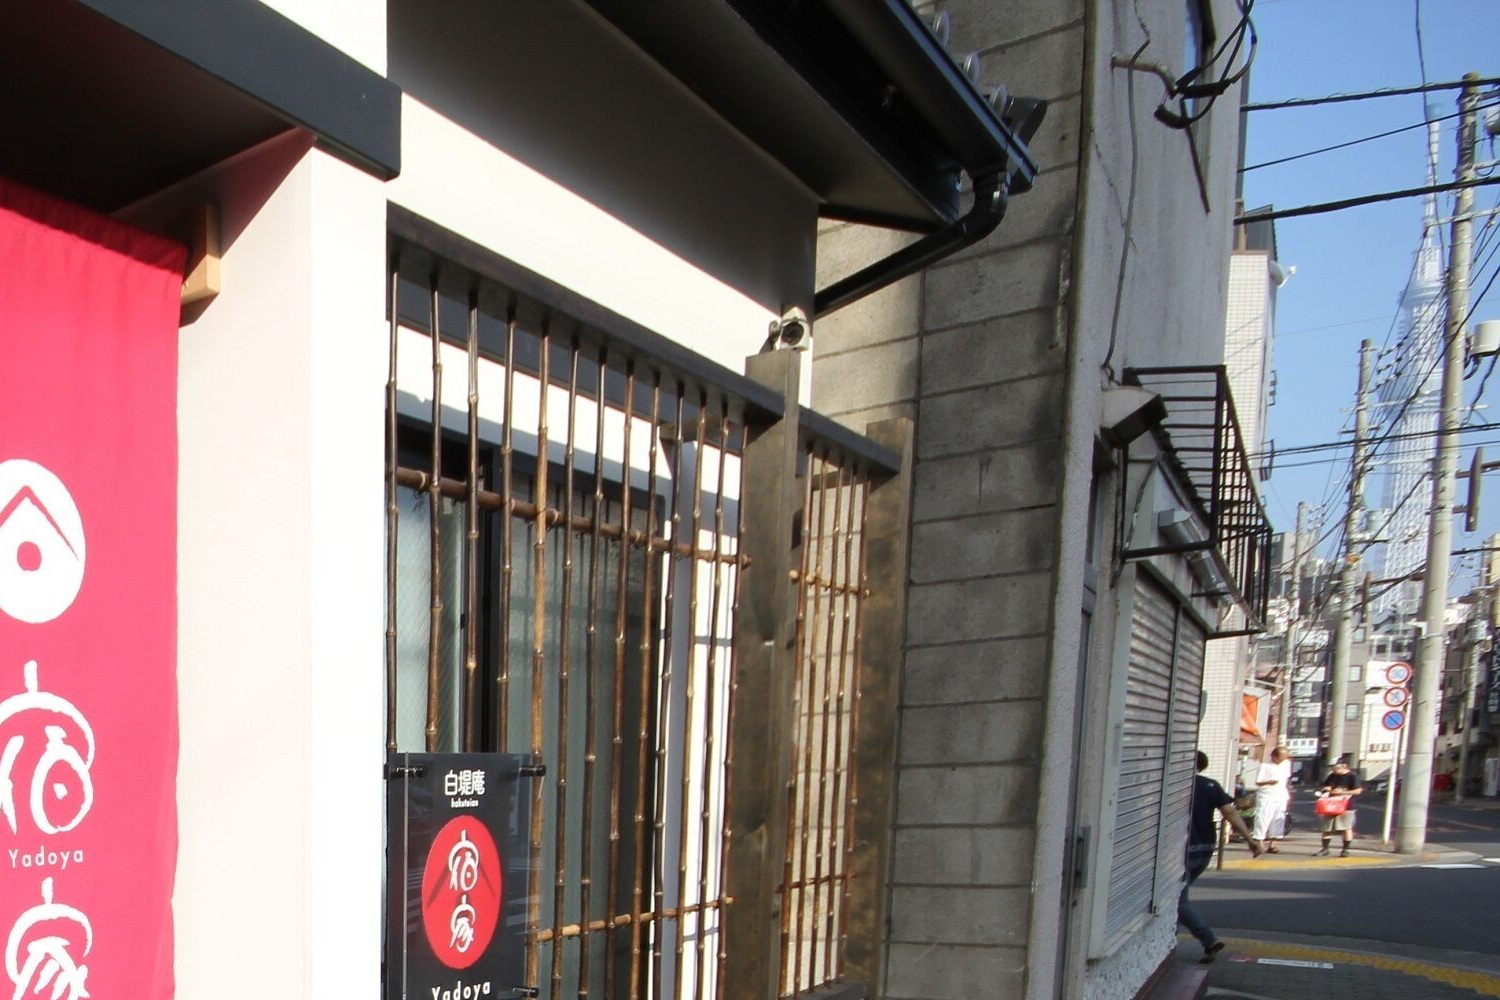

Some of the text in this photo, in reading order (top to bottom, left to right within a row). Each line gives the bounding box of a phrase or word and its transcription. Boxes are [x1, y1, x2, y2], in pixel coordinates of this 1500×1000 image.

[444, 769, 486, 796] 白堤庵
[8, 845, 84, 870] Yadoya
